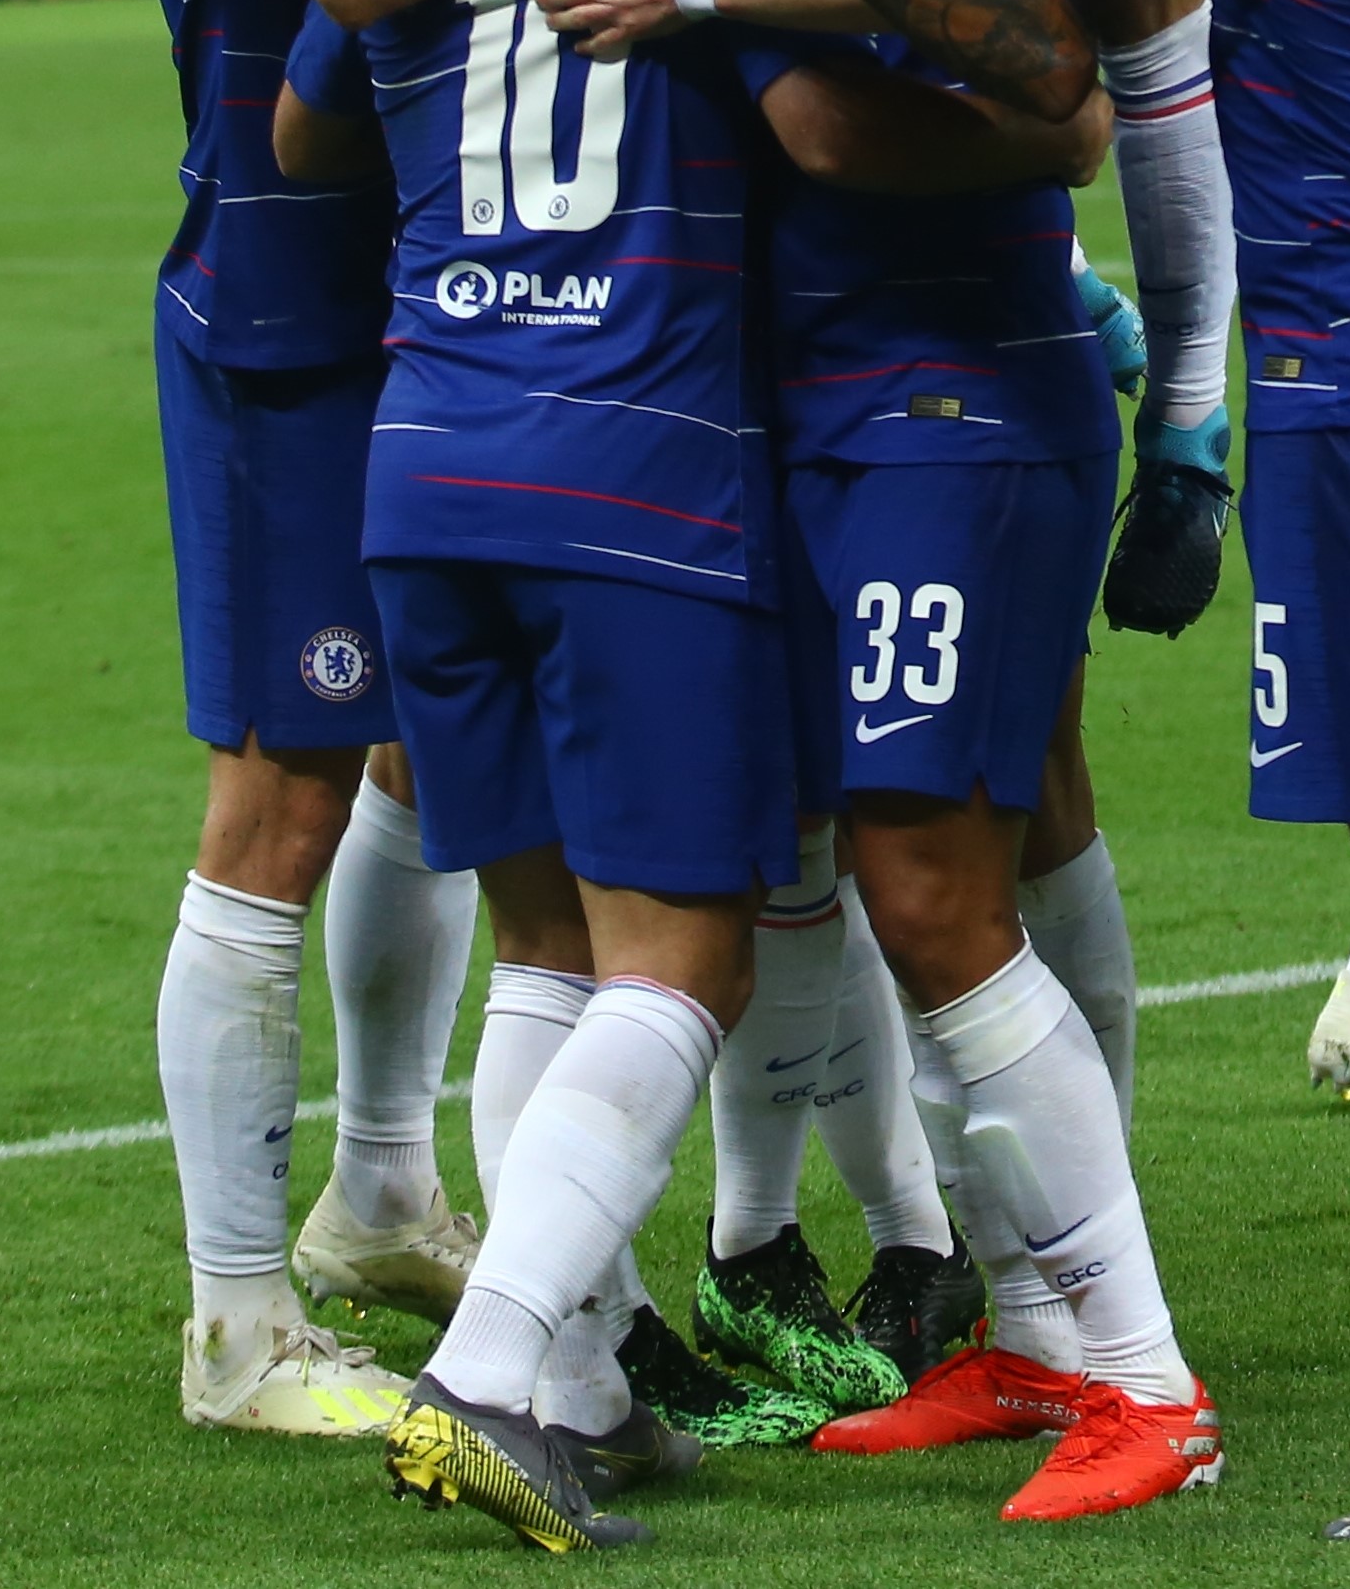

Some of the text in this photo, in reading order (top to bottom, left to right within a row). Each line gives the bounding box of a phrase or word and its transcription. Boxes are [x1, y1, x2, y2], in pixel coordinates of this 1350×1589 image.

[502, 270, 613, 310] PLAN
[502, 311, 602, 327] INTERNATIONAL
[312, 630, 360, 648] CHELSEA
[850, 580, 965, 705] 33
[1254, 601, 1288, 728] 5
[772, 1081, 817, 1104] CFC
[813, 1079, 865, 1108] CFC
[1056, 1261, 1107, 1288] CFC
